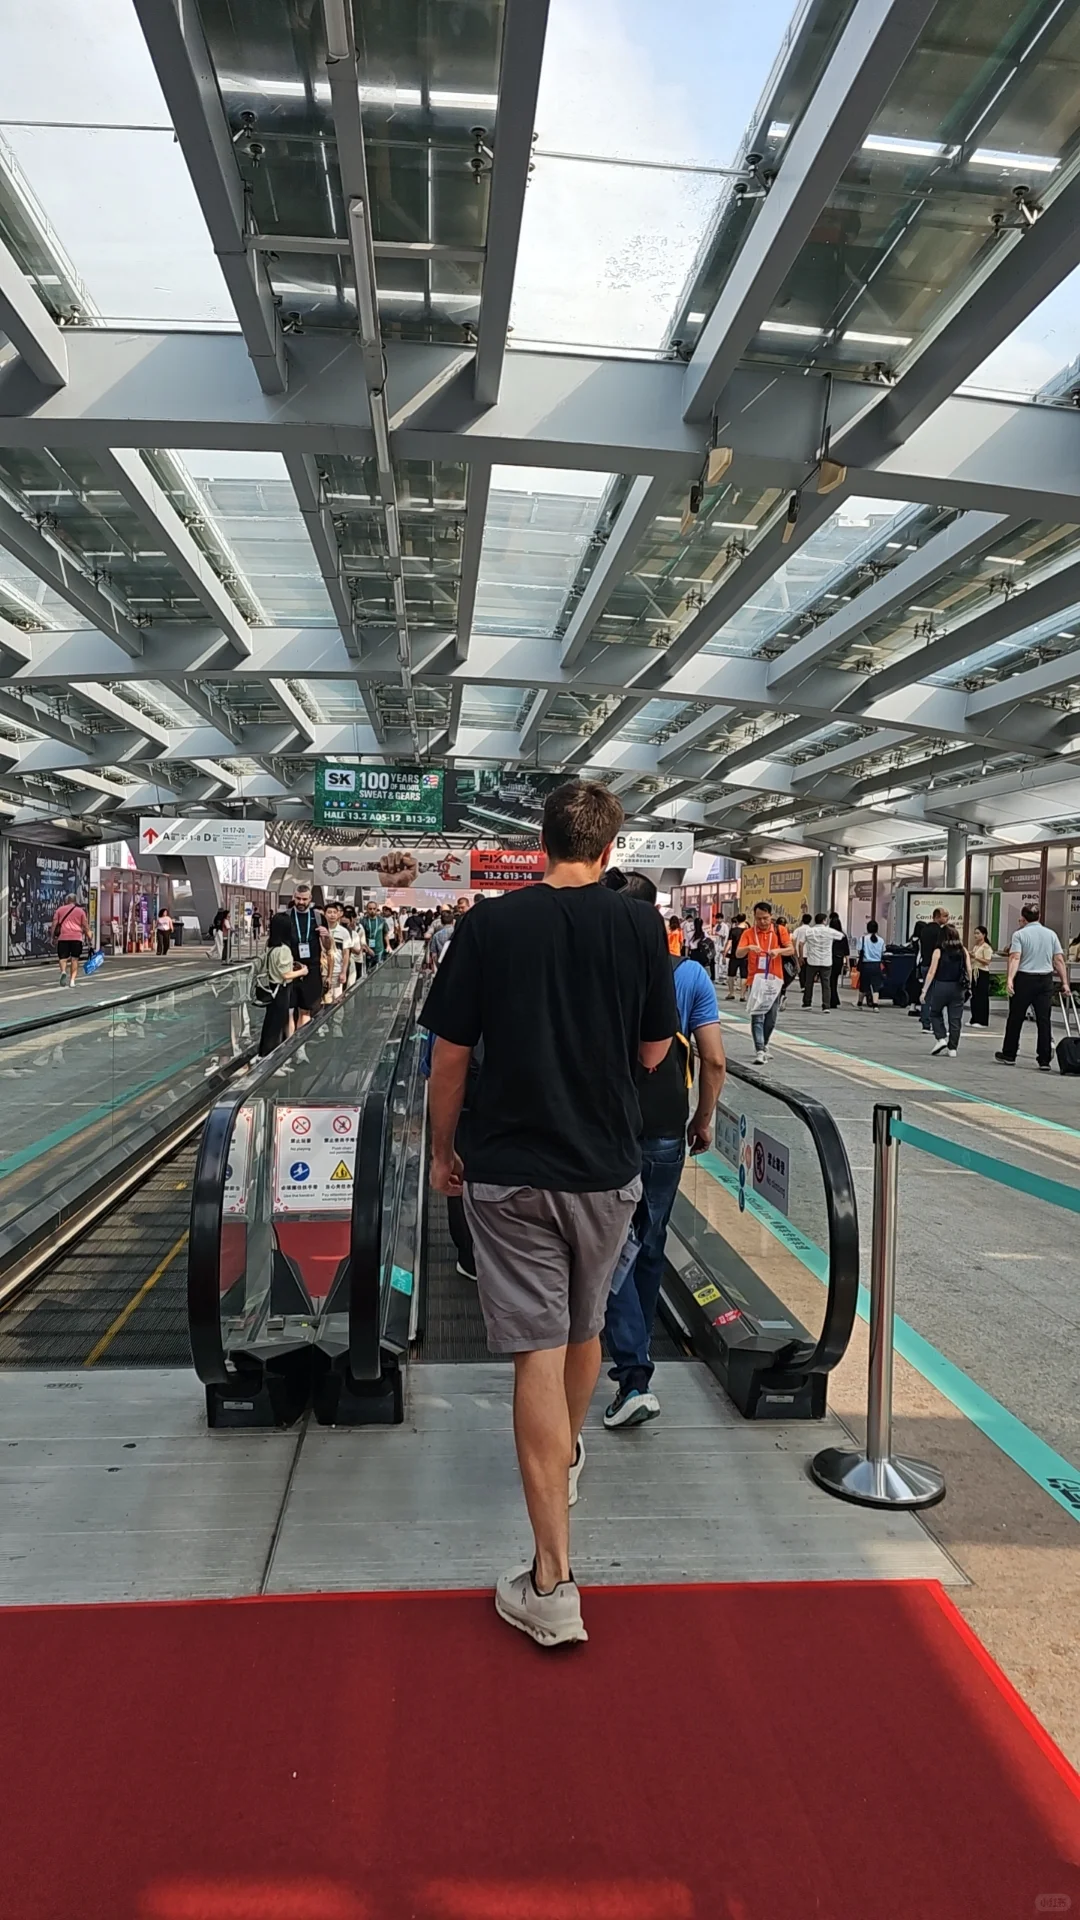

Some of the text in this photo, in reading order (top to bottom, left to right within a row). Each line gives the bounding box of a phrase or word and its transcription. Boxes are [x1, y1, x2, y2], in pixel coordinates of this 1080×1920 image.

[328, 772, 352, 785] SK
[359, 772, 389, 789] 100
[390, 773, 419, 783] YEARS
[359, 790, 387, 799] SWEAT
[395, 792, 421, 801] GEARS
[324, 811, 437, 823] HALL 13.2 A05-12 B13-20
[162, 832, 170, 841] A
[203, 833, 211, 842] D
[616, 836, 626, 849] B
[658, 841, 683, 850] 9-13
[479, 854, 538, 864] FIXMAN
[484, 871, 533, 880] 13.2 G13-14
